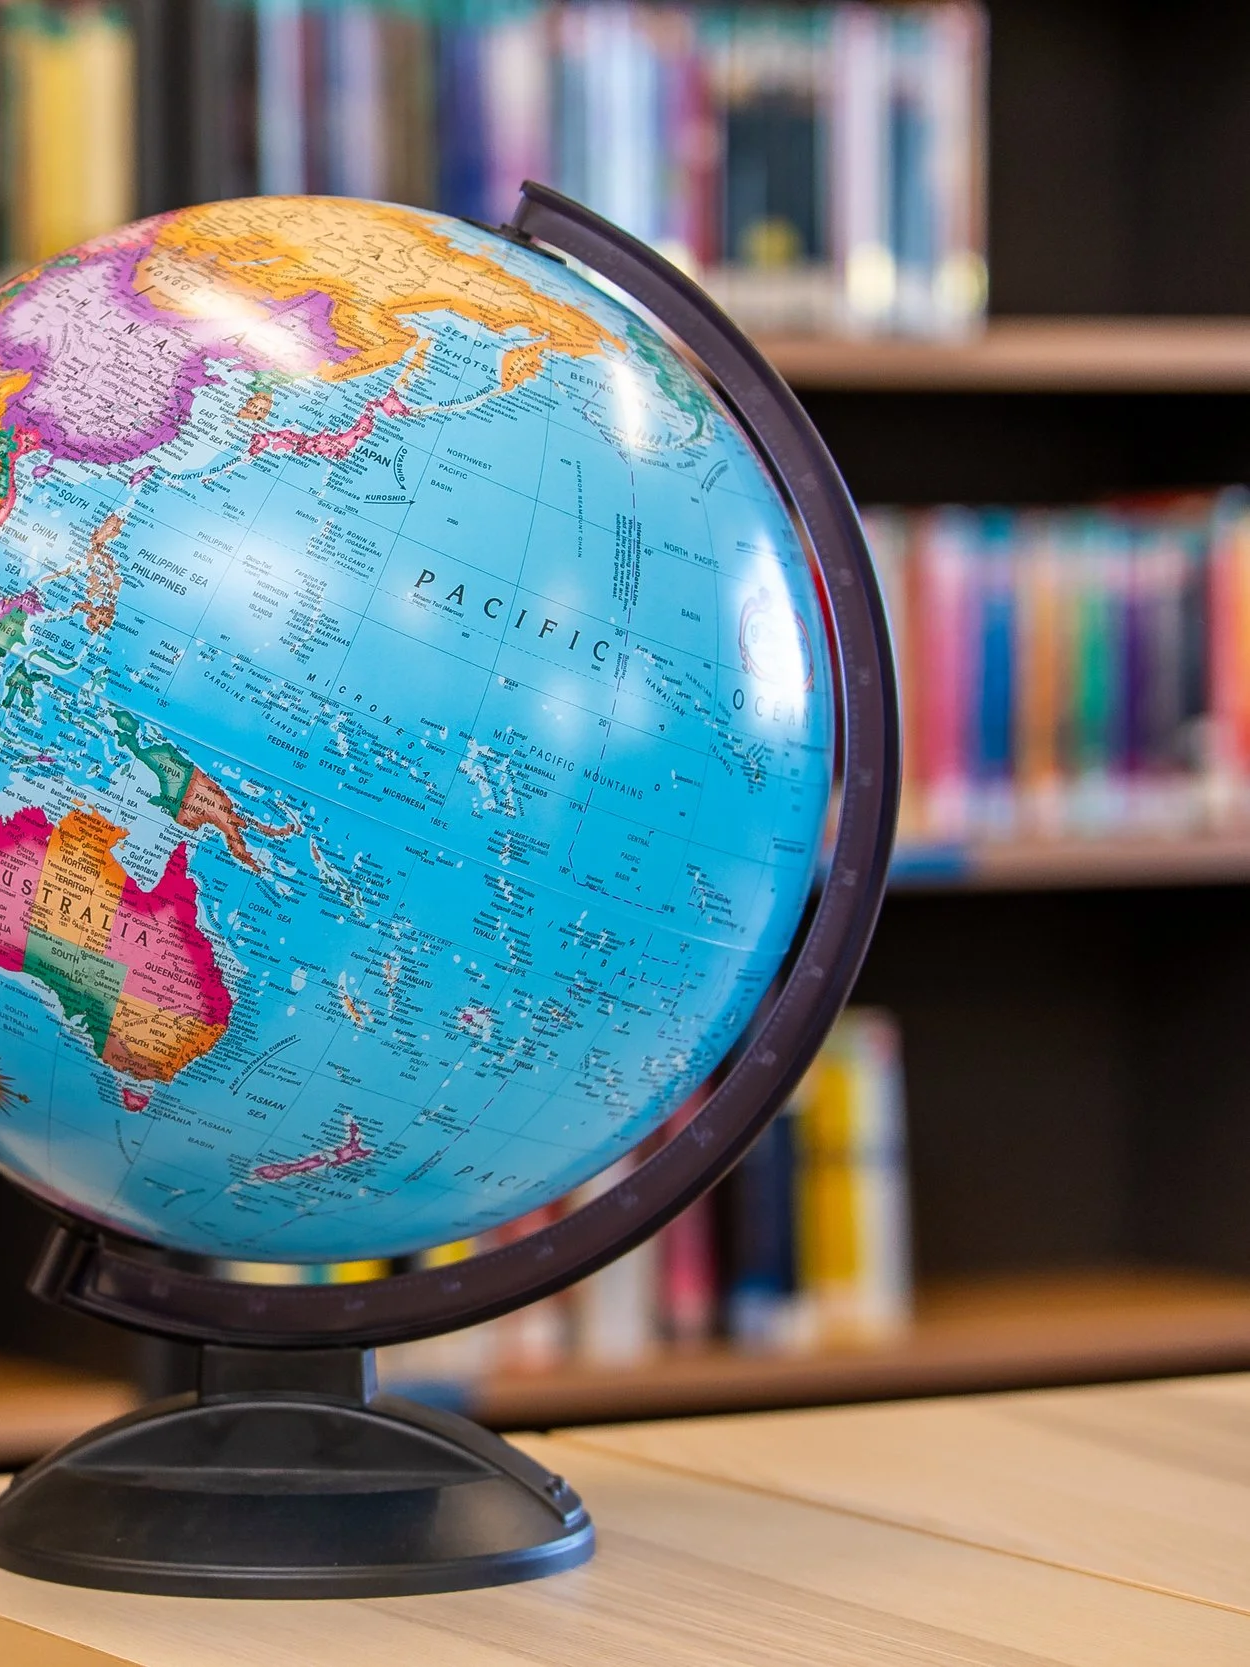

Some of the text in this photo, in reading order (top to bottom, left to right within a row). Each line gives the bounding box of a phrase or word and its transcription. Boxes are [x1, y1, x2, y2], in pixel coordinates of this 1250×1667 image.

[443, 325, 491, 351] SEA OF
[434, 344, 498, 376] OKHOTSK
[570, 372, 614, 395] BERING
[200, 390, 236, 410] YELLOW SEA
[314, 390, 328, 400] SEA
[438, 384, 494, 407] KURIL ISLANDS
[200, 408, 218, 420] EAST
[299, 404, 324, 418] JAPAN
[197, 419, 218, 432] CHINA
[209, 435, 223, 445] SEA
[224, 440, 247, 454] KYUSHU
[282, 453, 309, 468] SHIKOKU
[355, 445, 391, 467] JAPAN
[447, 448, 492, 471] NORTHWEST
[171, 456, 241, 480] RYUKYU ISLANDS
[399, 448, 408, 482] OYASHIO
[438, 463, 468, 480] PACIFIC
[431, 479, 453, 492] BASIN
[58, 489, 90, 510] SOUTH
[1, 525, 29, 544] VIETNAM
[32, 522, 60, 542] CHINA
[347, 531, 377, 548] BONIN IS.
[111, 540, 128, 550] LUZON
[198, 531, 234, 553] PHILIPPINE
[345, 539, 382, 558] (OGASAWARA)
[193, 551, 214, 564] BASIN
[336, 552, 375, 573] VOLCANO IS.
[664, 542, 719, 569] NORTH PACIFIC
[5, 563, 22, 578] SEA
[138, 549, 209, 588] PHILIPPINE SEA
[130, 562, 188, 596] PHILIPPINES
[47, 588, 69, 604] SULU SEA
[257, 580, 290, 599] NORTHERN
[252, 591, 279, 607] MARIANA
[248, 603, 273, 618] ISLANDS
[414, 569, 610, 662] PACIFIC
[682, 609, 700, 623] BASIN
[112, 620, 139, 636] MINDANAO
[30, 624, 76, 651] CELEBES SEA
[310, 635, 329, 648] Saipan
[315, 628, 351, 648] MARIANAS
[160, 640, 179, 654] PALAU
[294, 649, 311, 660] Guam
[614, 652, 622, 679] Monday
[203, 671, 245, 702] CAROLINE
[15, 723, 44, 741] FLORES SEA
[261, 711, 298, 738] ISLANDS
[59, 731, 87, 748] BANDA SEA
[267, 734, 309, 759] FEDERATED
[158, 763, 181, 779] PAPUA
[318, 759, 346, 776] STATES
[524, 764, 557, 781] MARSHALL
[529, 746, 575, 772] PACIFIC
[584, 768, 644, 800] MOUNTAINS
[22, 775, 46, 790] TIMOR SEA
[358, 777, 369, 785] OF
[65, 786, 88, 800] Melville
[98, 787, 138, 809] ARAFURA SEA
[382, 787, 427, 810] MICRONESIA
[522, 783, 548, 798] ISLANDS
[194, 794, 216, 808] PAPUA
[506, 829, 550, 849] GILBERT ISLANDS
[627, 833, 650, 847] CENTRAL
[129, 851, 144, 861] Gulf
[620, 852, 641, 864] PACIFIC
[61, 855, 101, 878] NORTHERN
[121, 856, 159, 877] Carpentaria
[54, 873, 95, 895] TERRITORY
[355, 872, 384, 888] SOLOMON
[615, 871, 630, 882] BASIN
[363, 888, 390, 901] ISLANDS
[248, 902, 292, 925] CORAL SEA
[472, 927, 496, 941] TUVALU
[51, 946, 80, 964] SOUTH
[38, 959, 84, 986] AUSTRALIA
[144, 961, 202, 989] QUEENSLAND
[403, 972, 433, 989] VANUATU
[4, 1004, 28, 1019] SOUTH
[314, 1003, 352, 1020] CALEDONIA
[328, 1001, 343, 1010] NEW
[2, 1023, 25, 1037] BASIN
[149, 1028, 167, 1038] NEW
[444, 1032, 458, 1041] FIJI
[124, 1034, 178, 1059] SOUTH WALES
[240, 1052, 268, 1076] AUSTRALIA
[268, 1034, 297, 1052] CURRENT
[110, 1052, 148, 1071] VICTORIA
[194, 1060, 218, 1073] Sydney
[512, 1058, 534, 1070] TONGA
[245, 1092, 287, 1111] TASMAN
[147, 1107, 192, 1127] TASMANIA
[247, 1109, 267, 1120] SEA
[197, 1117, 233, 1135] TASMAN
[187, 1136, 215, 1150] BASIN
[333, 1172, 360, 1184] NEW
[296, 1181, 352, 1200] ZEALAND
